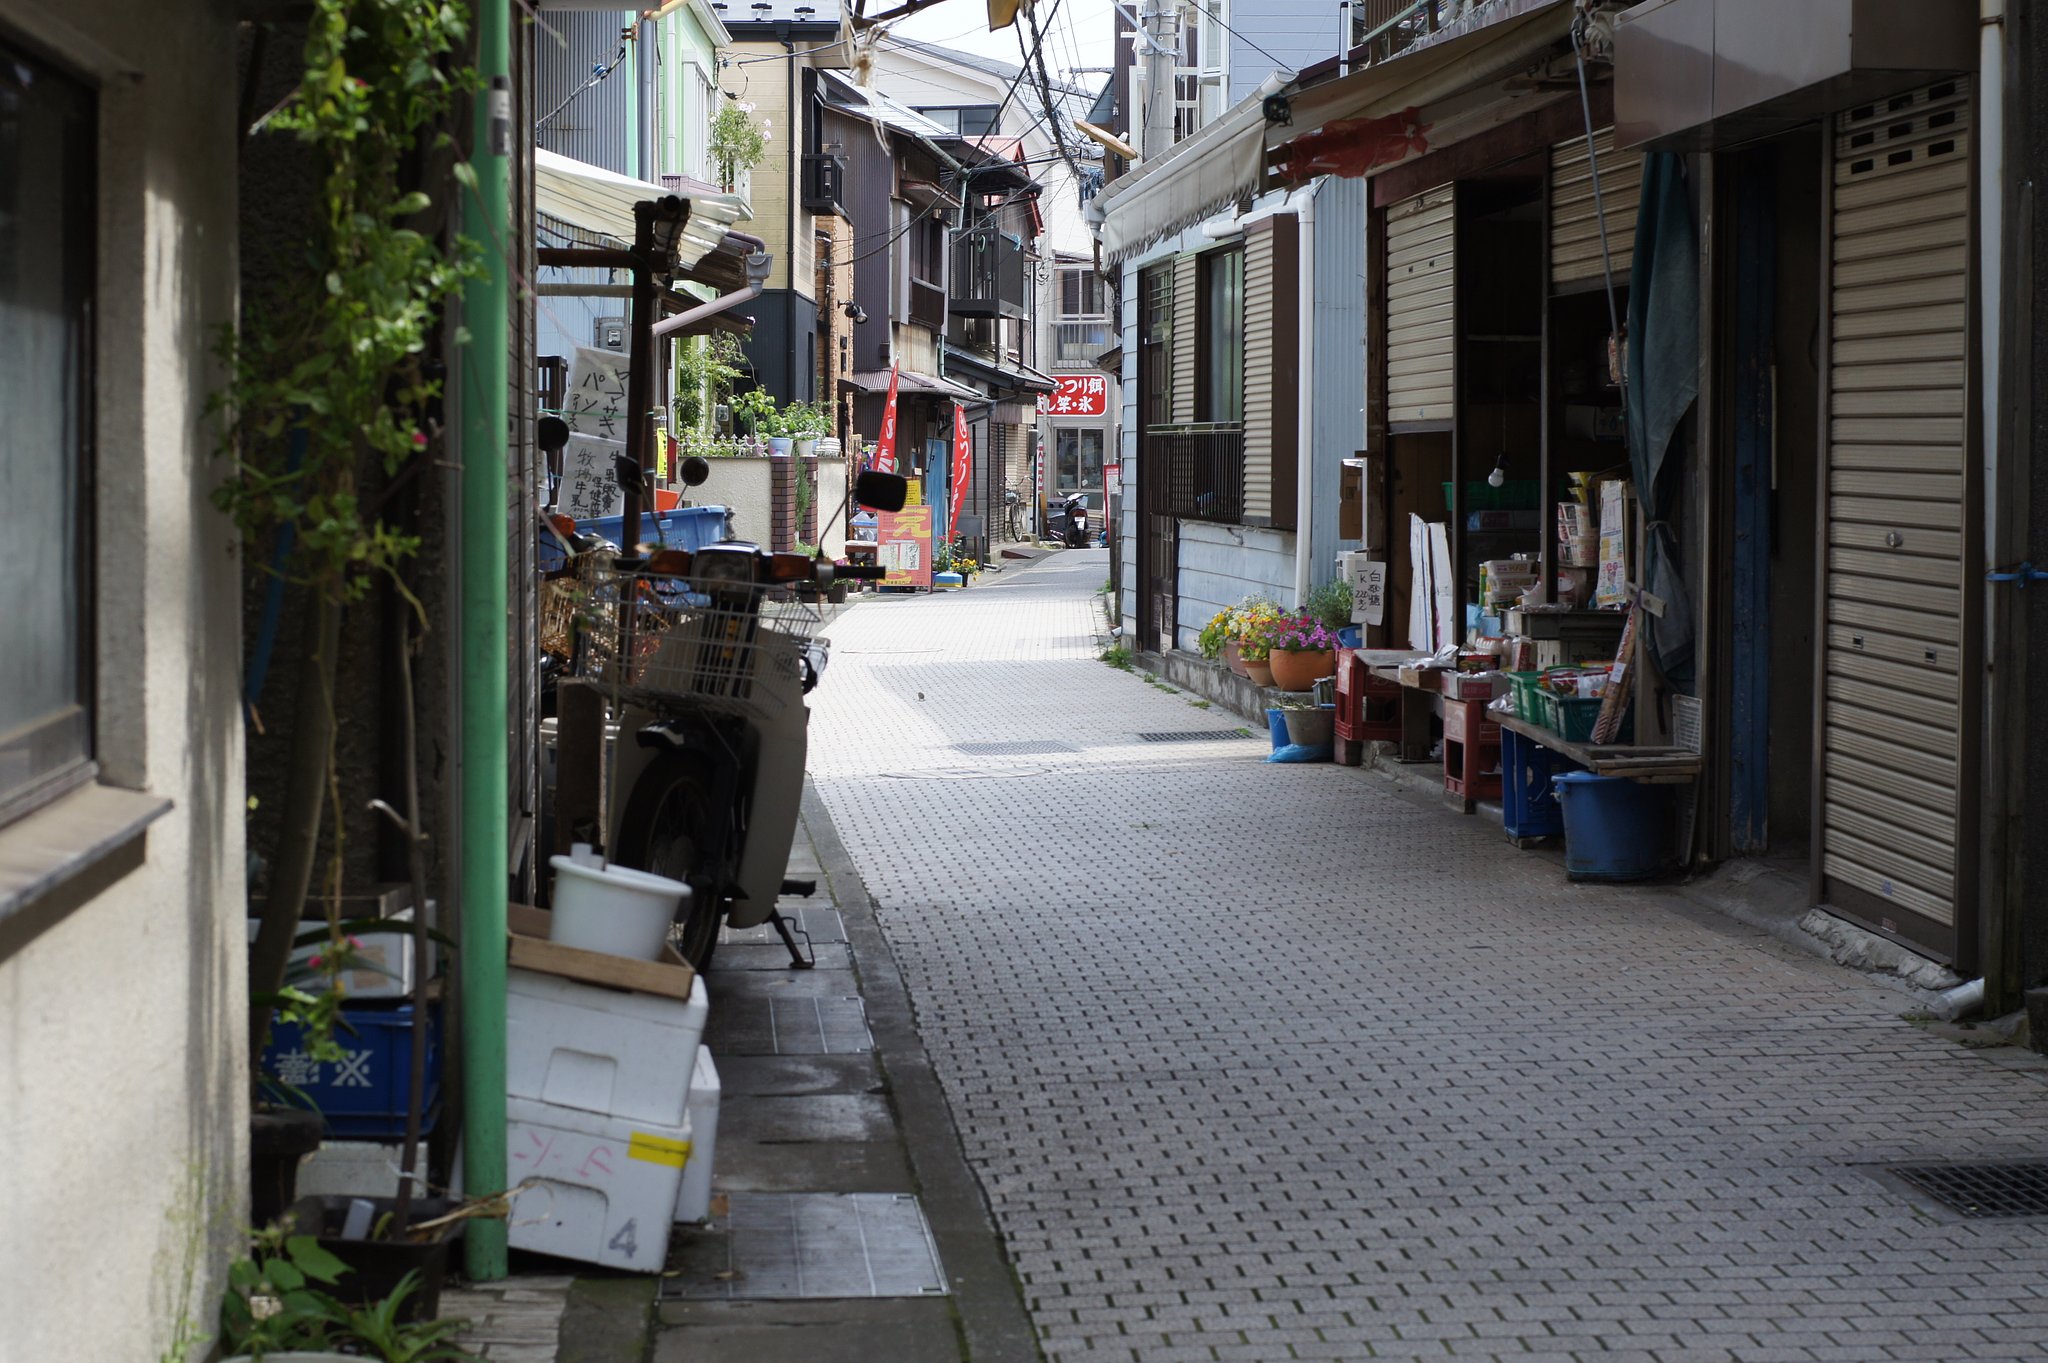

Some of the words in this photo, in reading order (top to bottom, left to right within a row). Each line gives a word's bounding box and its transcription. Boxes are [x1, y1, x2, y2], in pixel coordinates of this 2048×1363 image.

[580, 372, 605, 412] パン
[1053, 377, 1104, 396] ・つり餌
[1367, 569, 1382, 606] 白砂糖
[608, 1217, 638, 1260] 4
